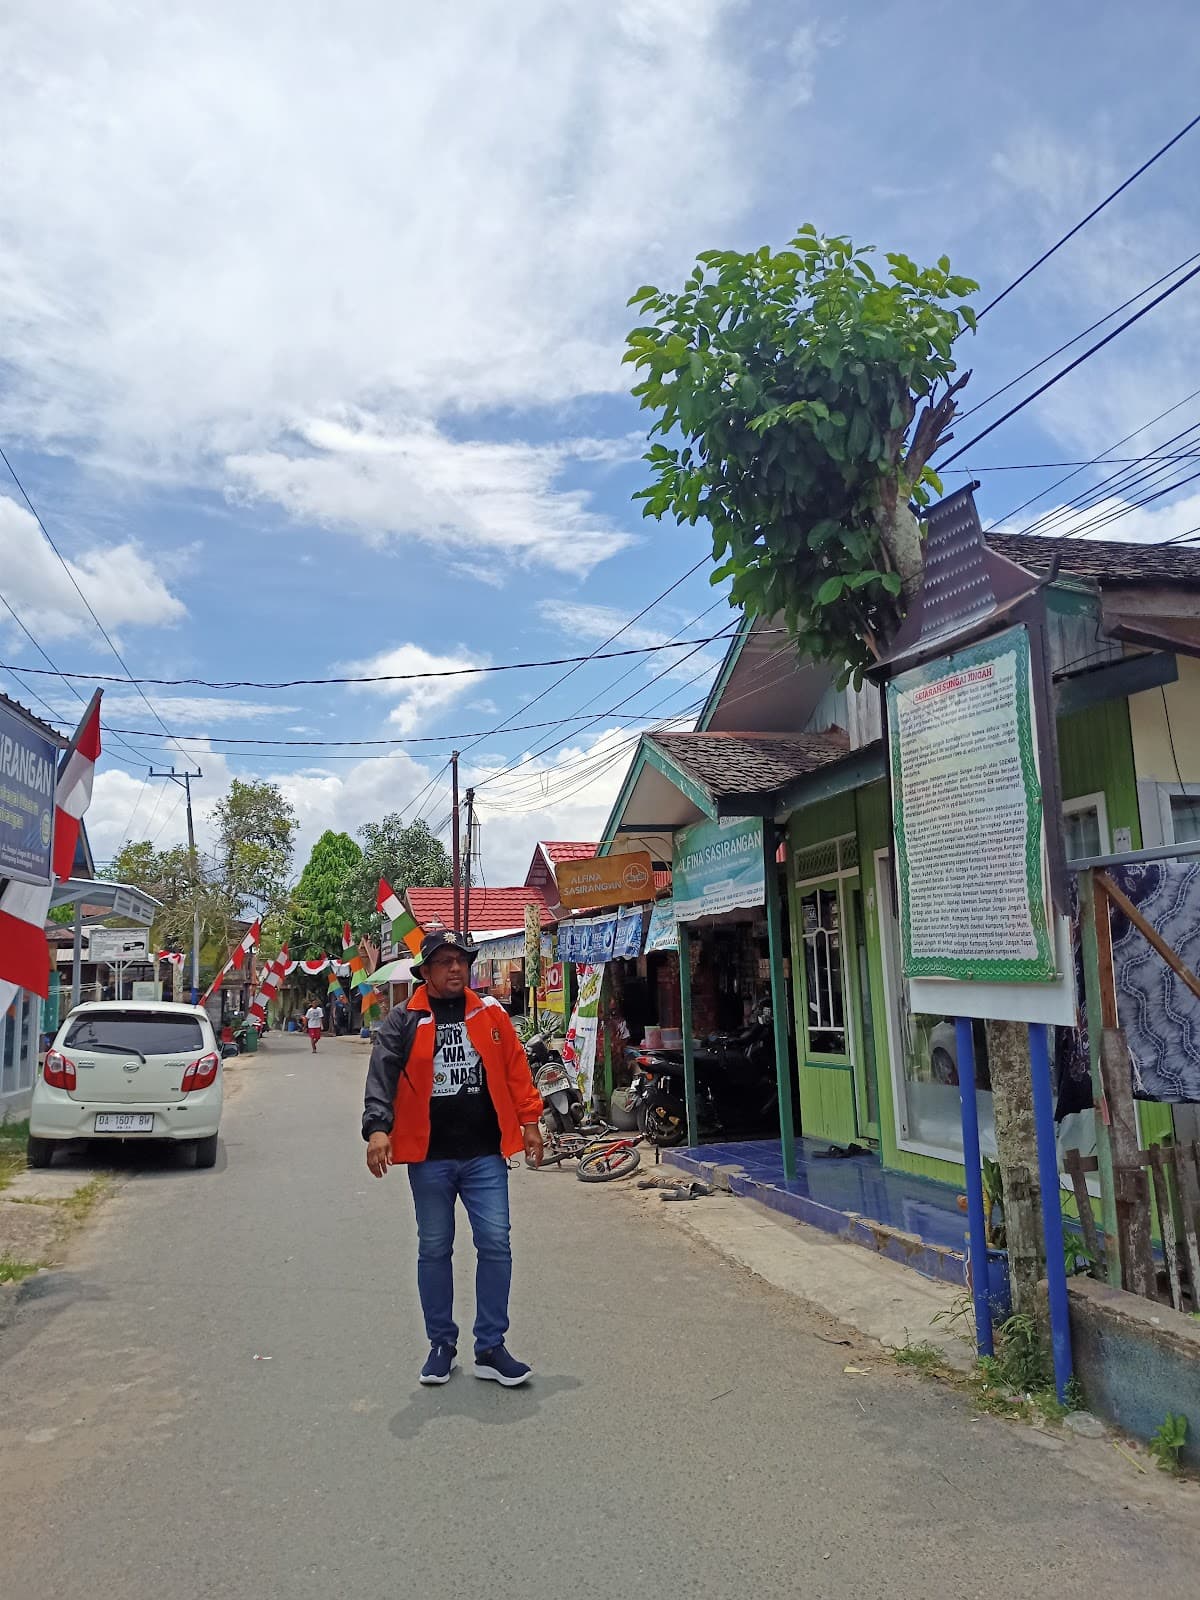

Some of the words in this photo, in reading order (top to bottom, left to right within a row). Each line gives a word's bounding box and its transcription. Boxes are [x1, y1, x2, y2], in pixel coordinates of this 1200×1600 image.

[915, 686, 941, 701] SEJARAH
[942, 675, 966, 691] SUNGAI
[967, 667, 991, 682] JINGAH
[676, 851, 704, 873] ALFINA
[705, 830, 762, 864] SASIRANGAN
[571, 873, 602, 885] ALFINA
[563, 881, 623, 896] SASIRANGAN
[437, 1029, 463, 1046] POR
[443, 1046, 466, 1062] WA
[450, 1068, 478, 1086] NAS
